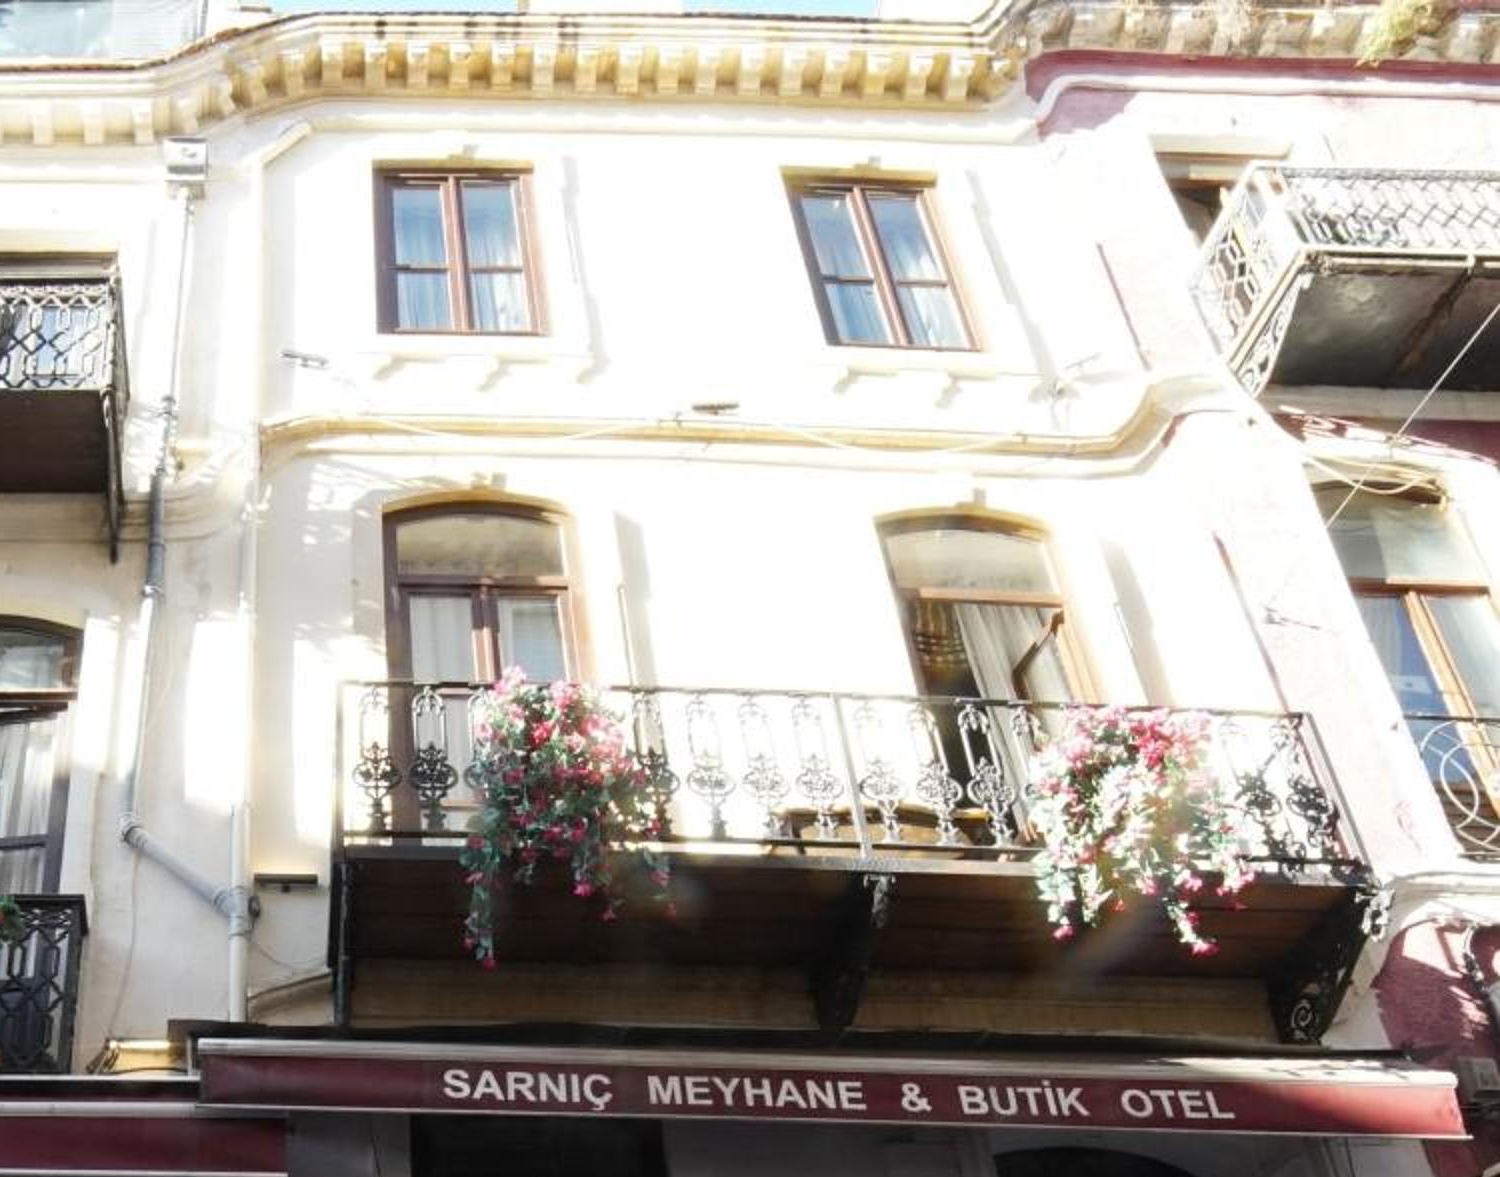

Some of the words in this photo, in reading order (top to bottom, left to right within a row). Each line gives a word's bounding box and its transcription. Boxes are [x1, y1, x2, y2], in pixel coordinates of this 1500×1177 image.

[443, 1069, 612, 1111] SARNIÇ
[647, 1075, 867, 1110] MEYHANE
[901, 1082, 932, 1113] &
[957, 1080, 1090, 1116] BUTİK
[1121, 1089, 1235, 1119] OTEL
